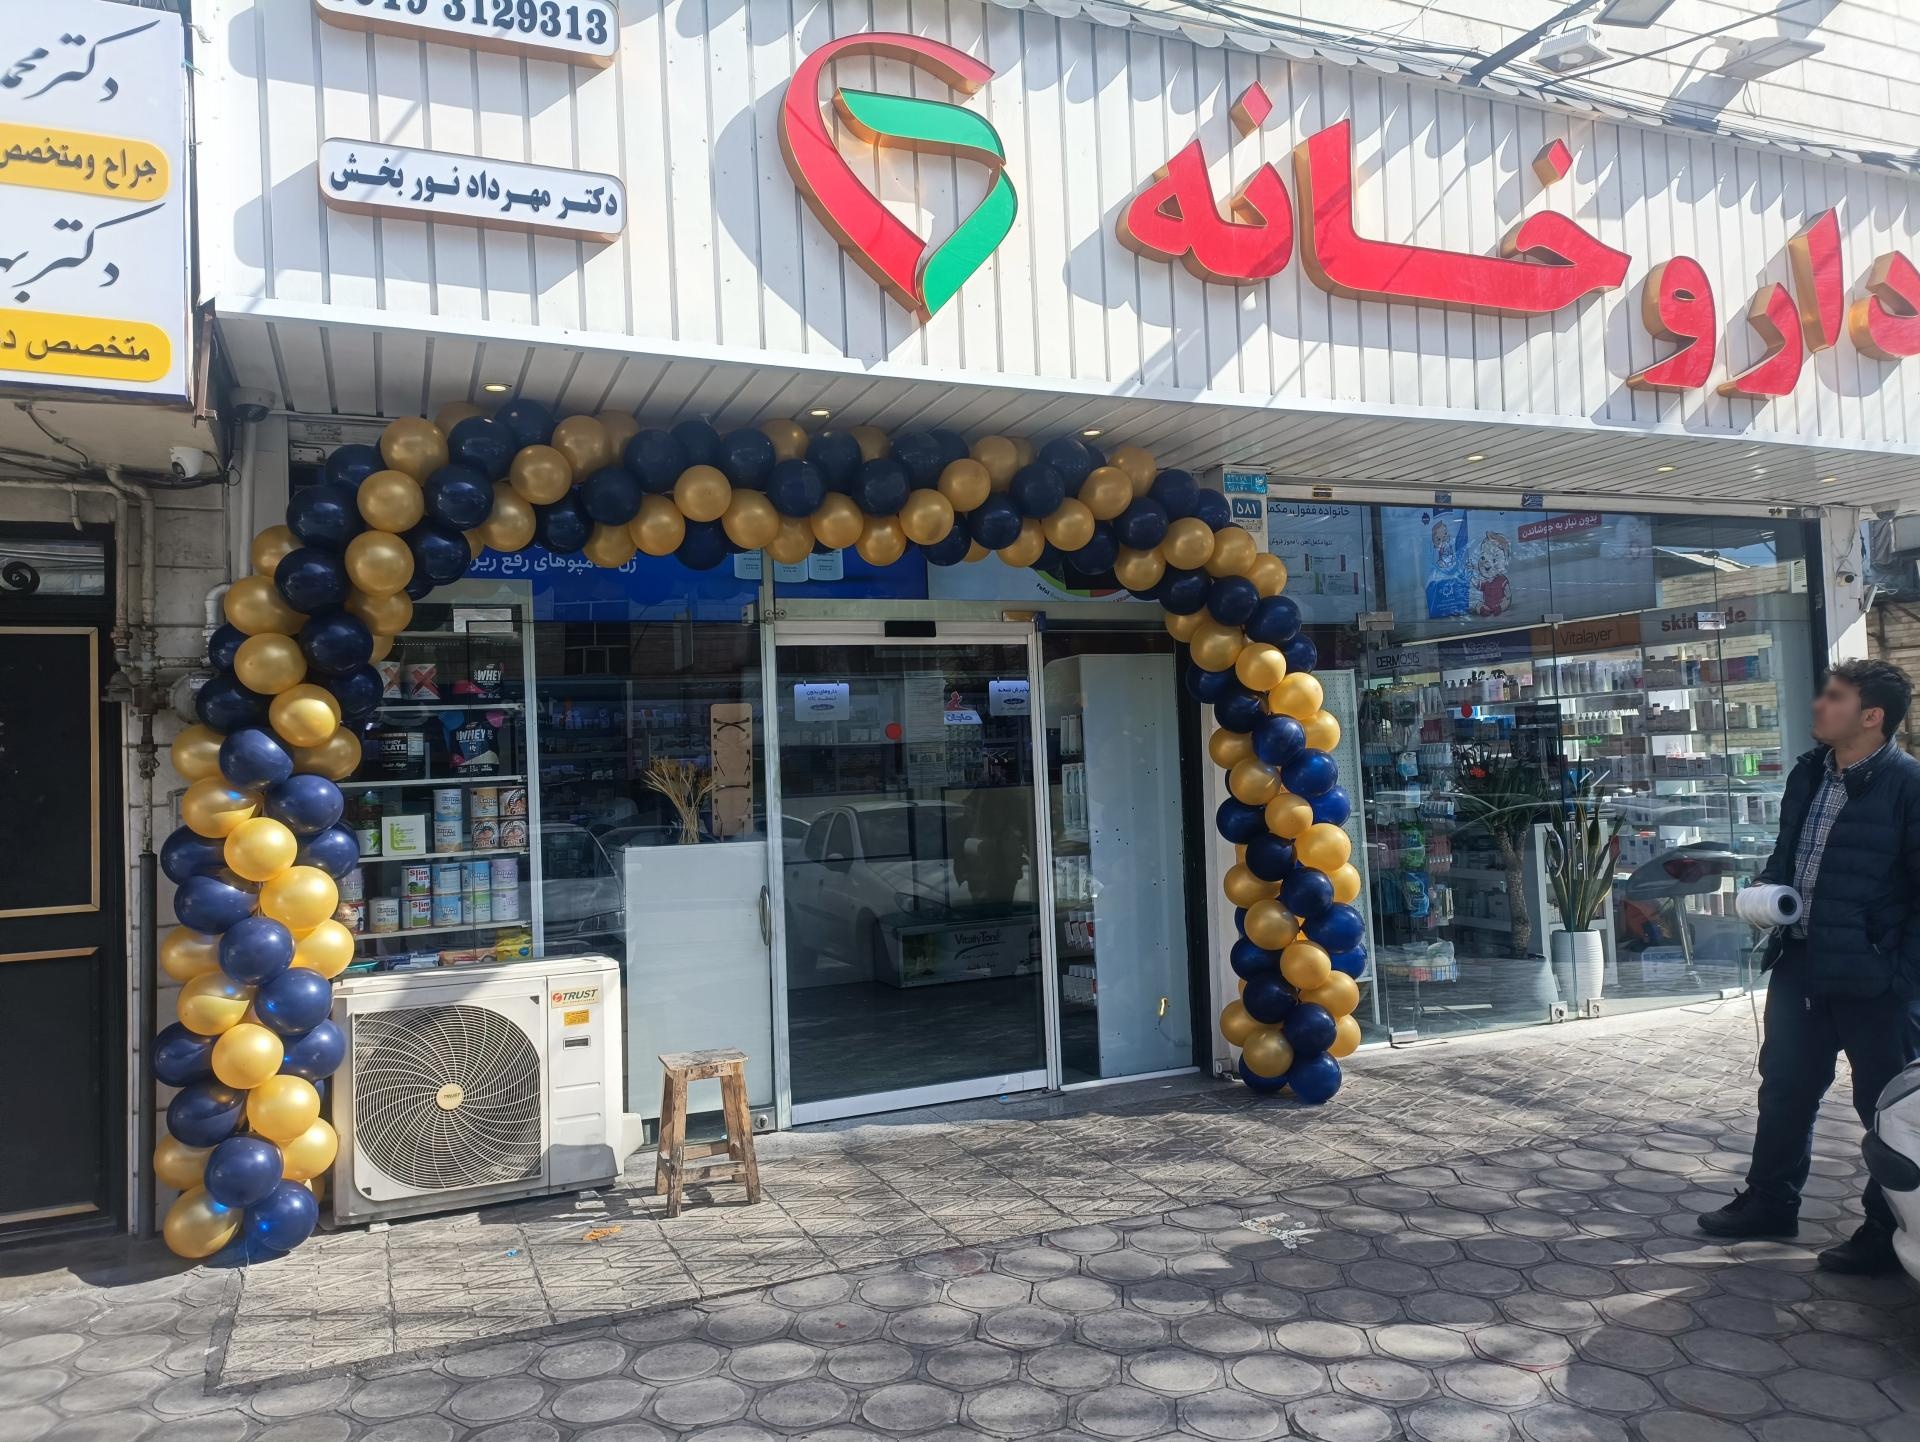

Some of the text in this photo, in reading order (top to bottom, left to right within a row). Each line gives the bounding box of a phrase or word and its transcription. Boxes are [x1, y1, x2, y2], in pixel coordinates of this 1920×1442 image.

[23, 19, 161, 100] دکتر
[102, 148, 157, 189] جراح
[466, 169, 550, 212] مهرداد
[557, 186, 618, 219] دکتر
[10, 202, 167, 288] دکتر
[25, 335, 150, 361] متخصص
[501, 554, 530, 574] رفع
[1661, 606, 1746, 632] skinde
[1560, 626, 1614, 646] Vitalayer
[1376, 652, 1420, 668] DERMOSIS
[478, 669, 502, 681] WHEY
[459, 728, 486, 741] WHEY
[409, 868, 428, 876] Slim
[411, 900, 430, 909] Slim
[563, 988, 598, 1001] TRUST
